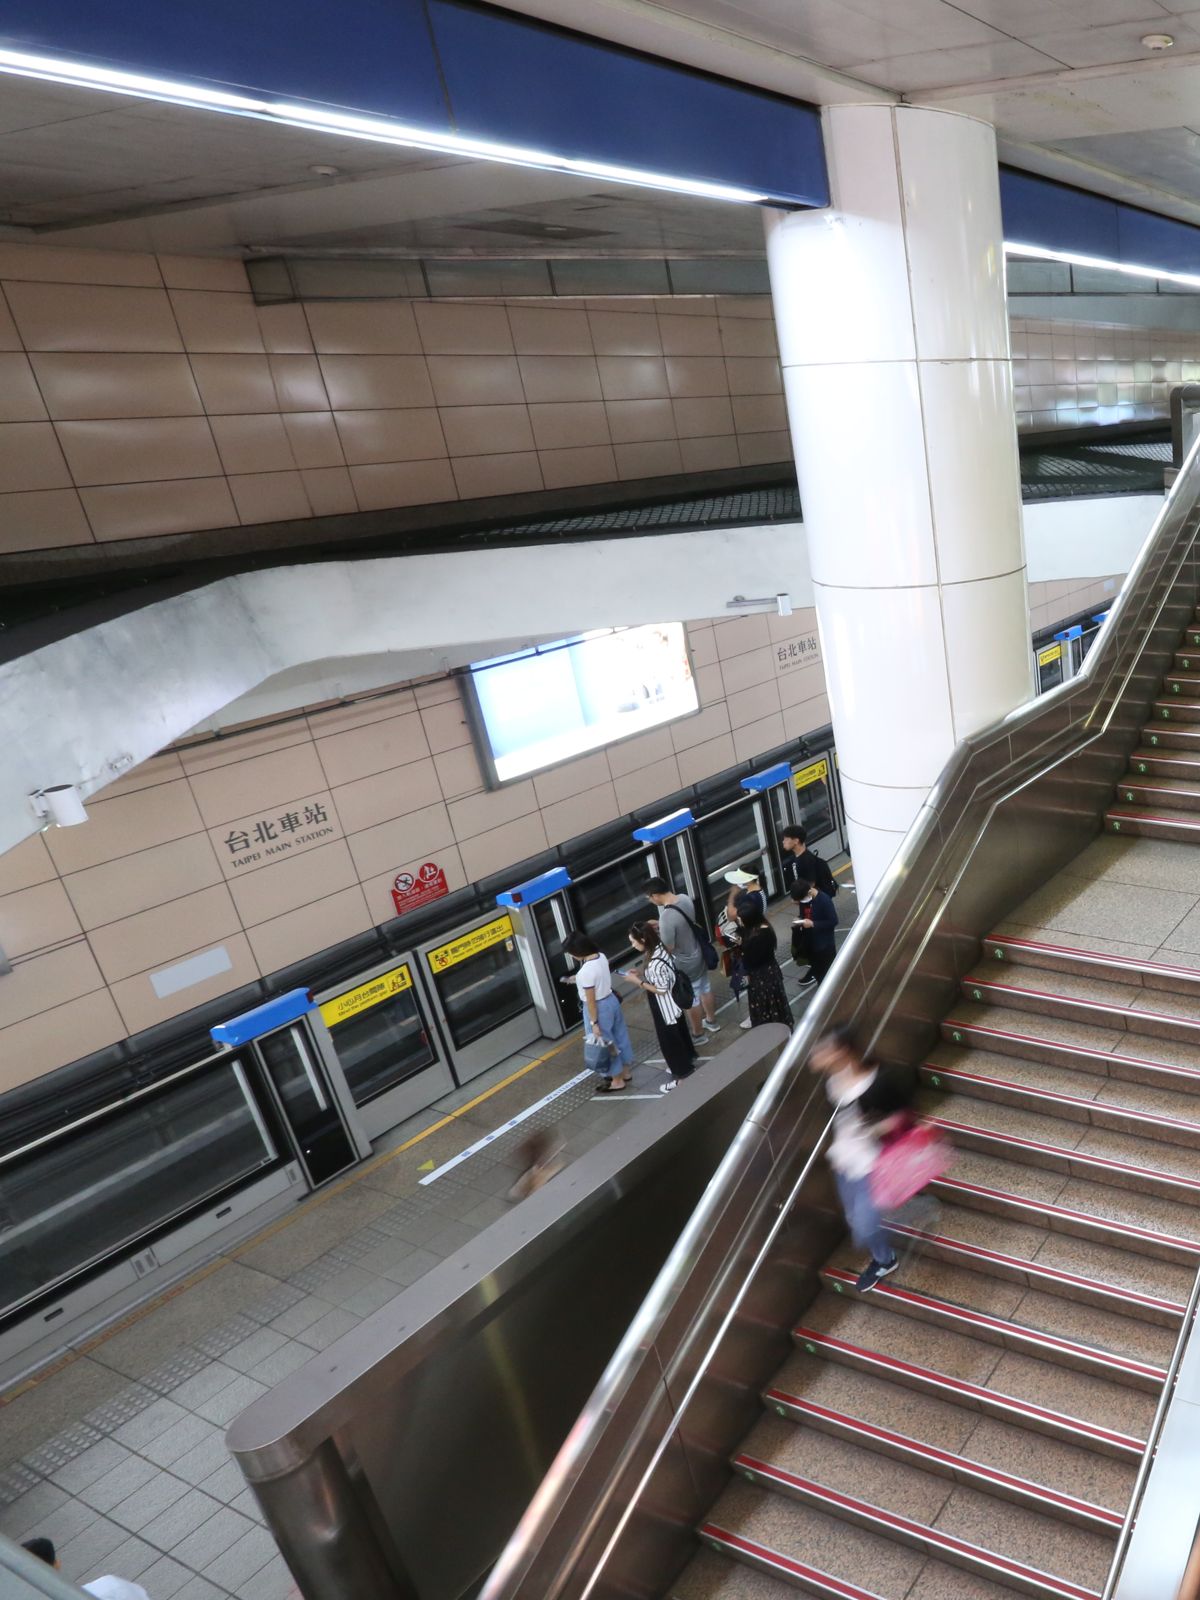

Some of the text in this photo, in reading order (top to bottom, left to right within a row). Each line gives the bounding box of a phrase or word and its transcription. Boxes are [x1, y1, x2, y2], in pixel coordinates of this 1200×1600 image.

[777, 636, 817, 662] 台北車站
[224, 802, 328, 854] 台北車站
[231, 826, 334, 868] TAIPEI MAIN STATION
